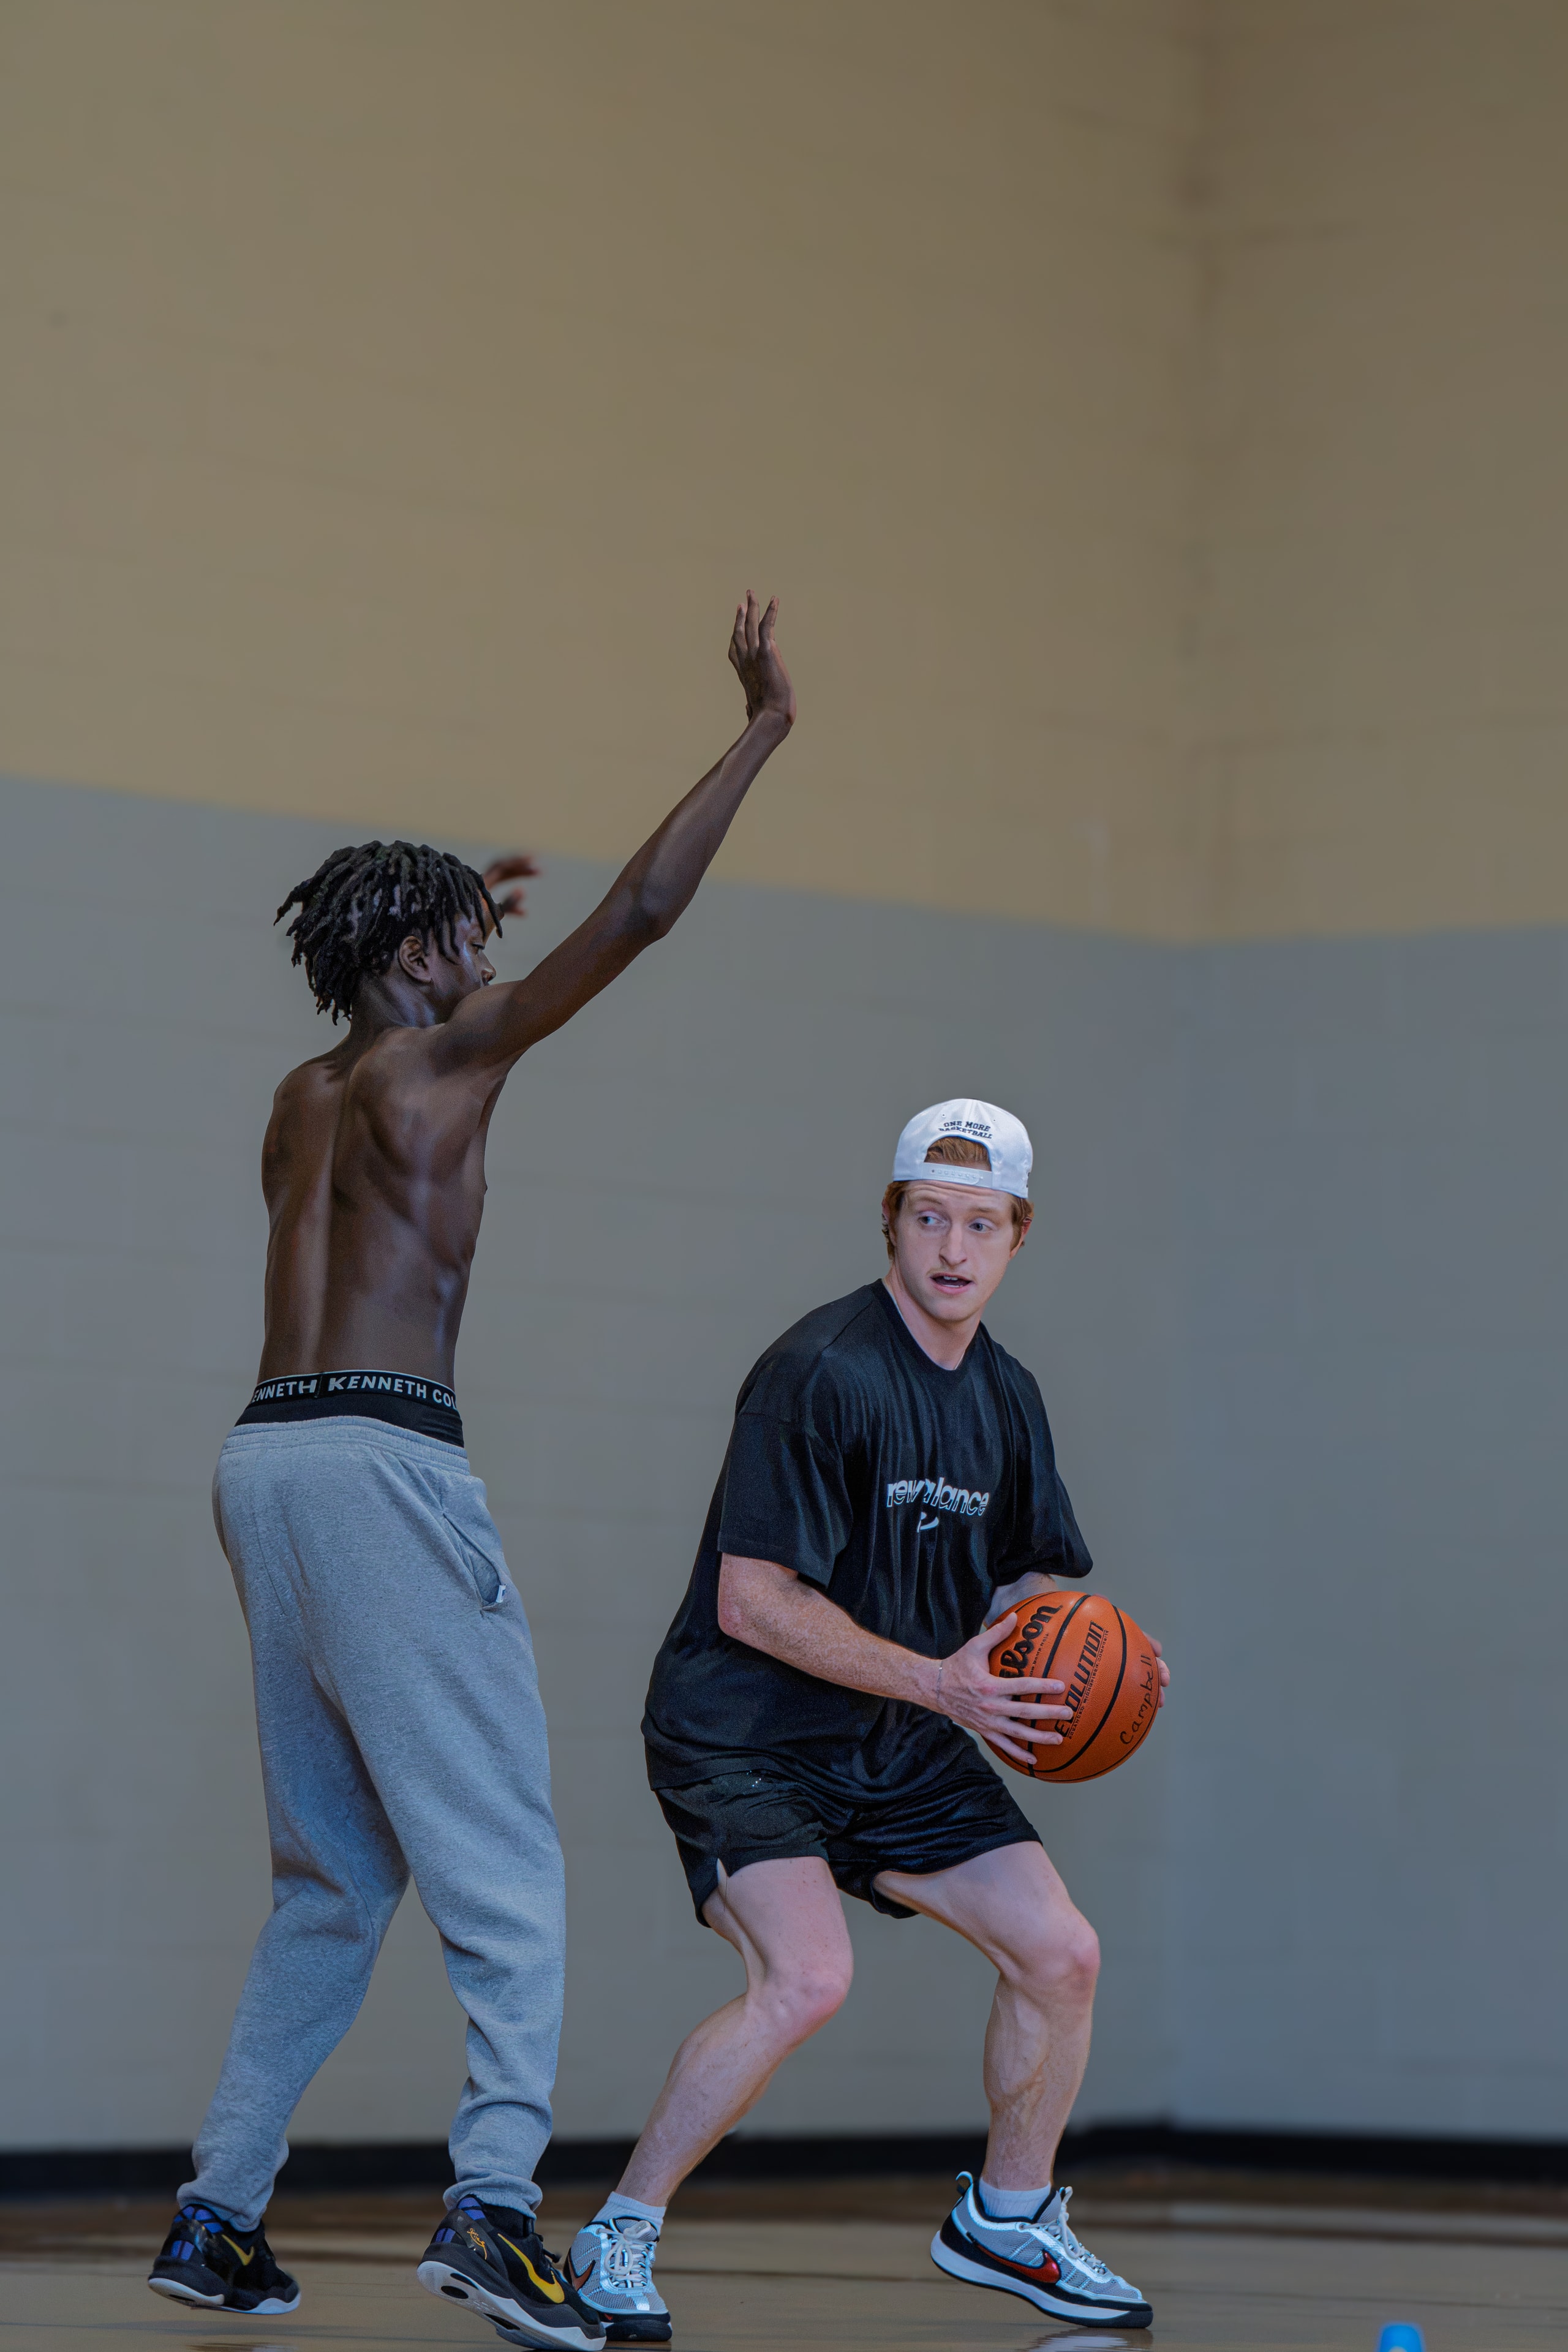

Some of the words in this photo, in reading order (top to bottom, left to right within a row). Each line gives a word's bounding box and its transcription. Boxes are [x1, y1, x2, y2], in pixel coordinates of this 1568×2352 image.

[938, 1126, 993, 1139] BASKETBALL
[965, 1121, 991, 1131] MORE
[328, 1375, 427, 1399] KENNETH
[999, 1605, 1061, 1694] ilson
[1054, 1620, 1105, 1738] EOLUTION
[1120, 1654, 1153, 1745] Campbell
